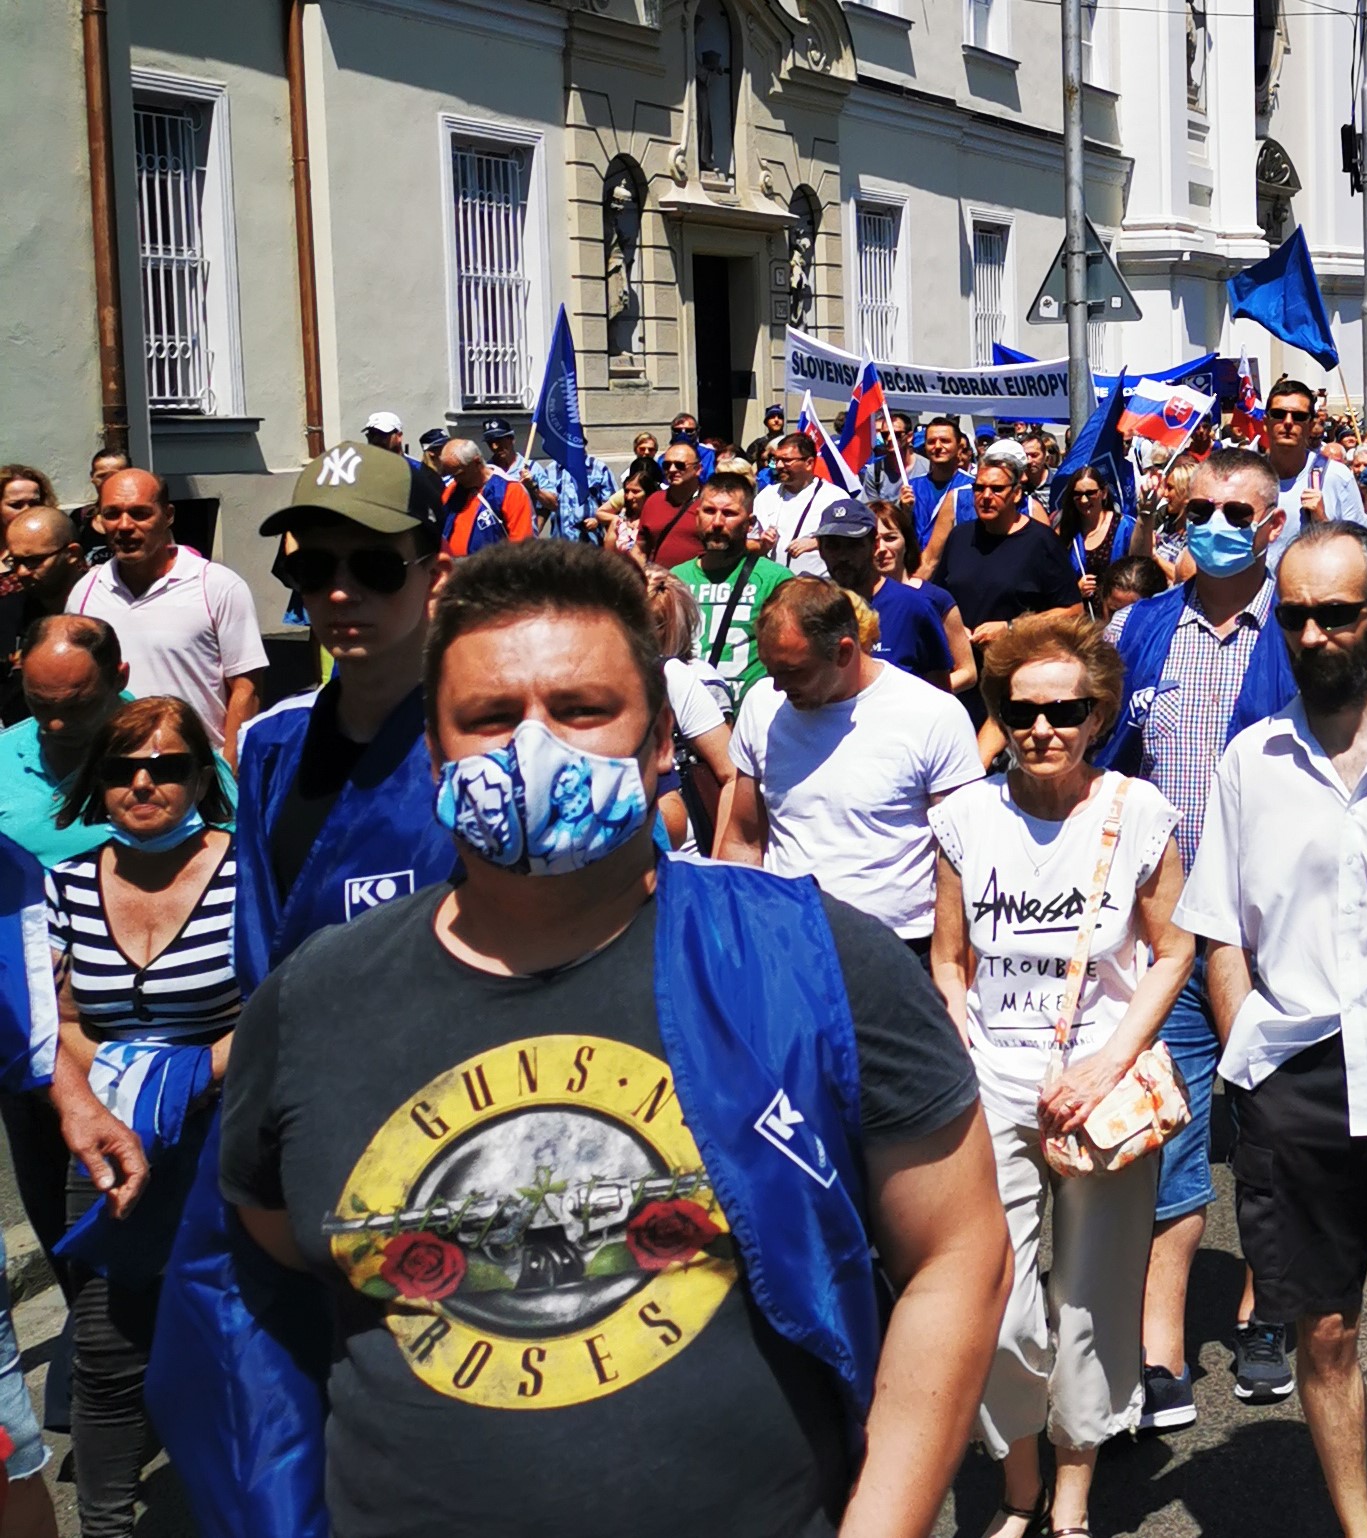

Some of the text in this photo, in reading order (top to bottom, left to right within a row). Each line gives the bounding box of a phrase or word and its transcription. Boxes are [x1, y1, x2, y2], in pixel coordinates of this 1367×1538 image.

[791, 350, 860, 387] SLOVENSK
[1003, 372, 1069, 397] EUROPY
[316, 446, 362, 486] NY
[984, 956, 1098, 978] TROUBE
[1000, 990, 1082, 1012] MAKE
[409, 1045, 596, 1141] GUNS
[408, 1301, 683, 1398] ROSES
